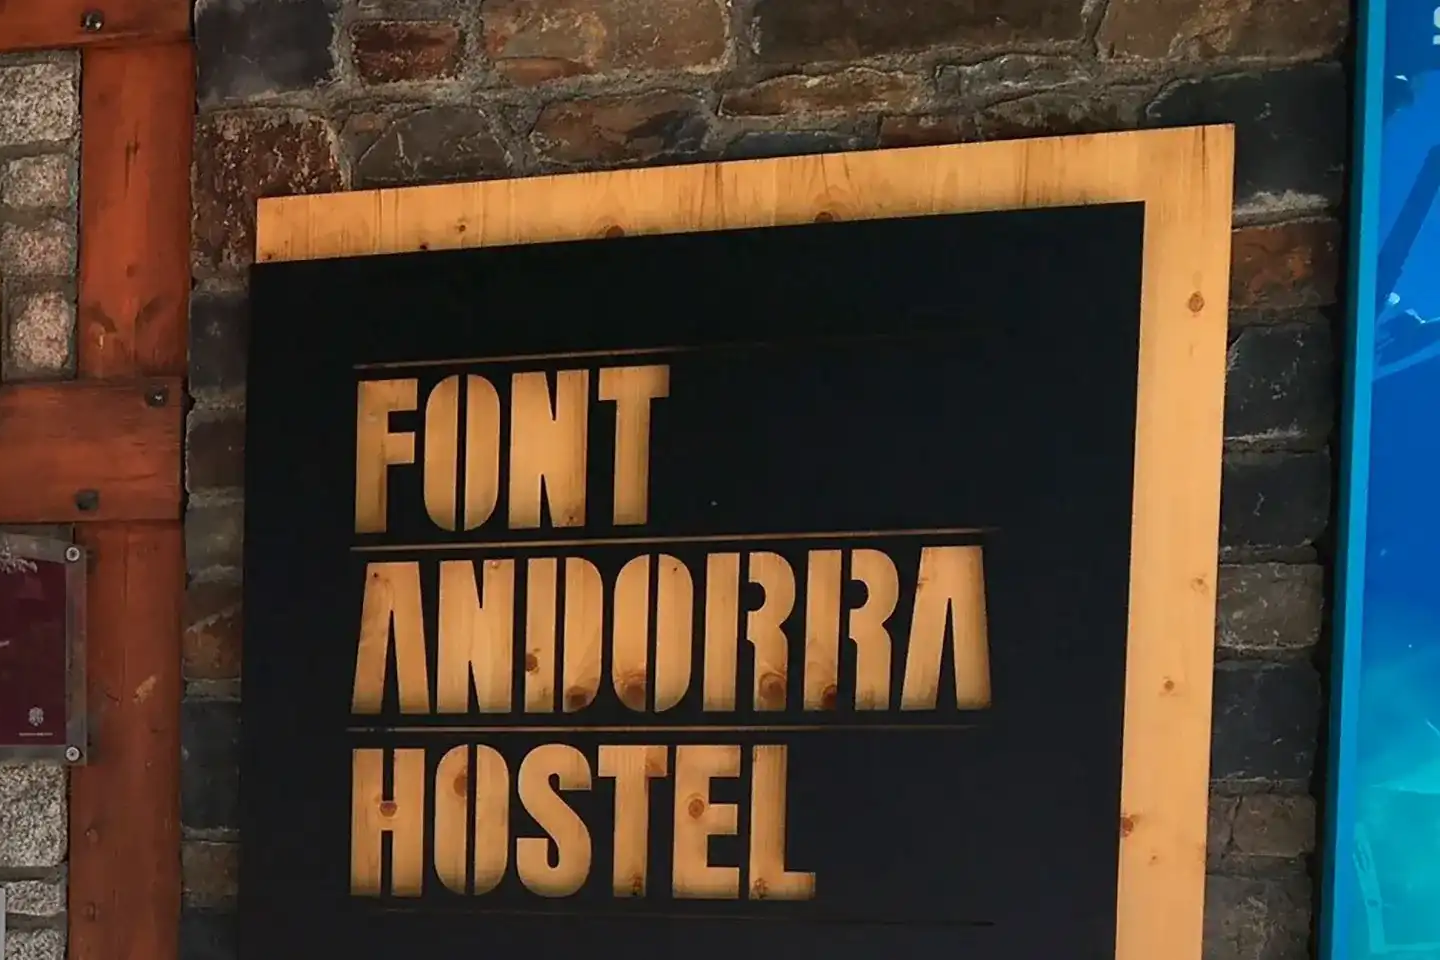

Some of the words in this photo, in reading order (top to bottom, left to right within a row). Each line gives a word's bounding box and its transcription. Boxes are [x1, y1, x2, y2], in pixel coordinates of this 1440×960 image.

[354, 364, 671, 534] FONT
[351, 545, 992, 714] ANDORRA
[350, 743, 816, 900] HOSTEL
